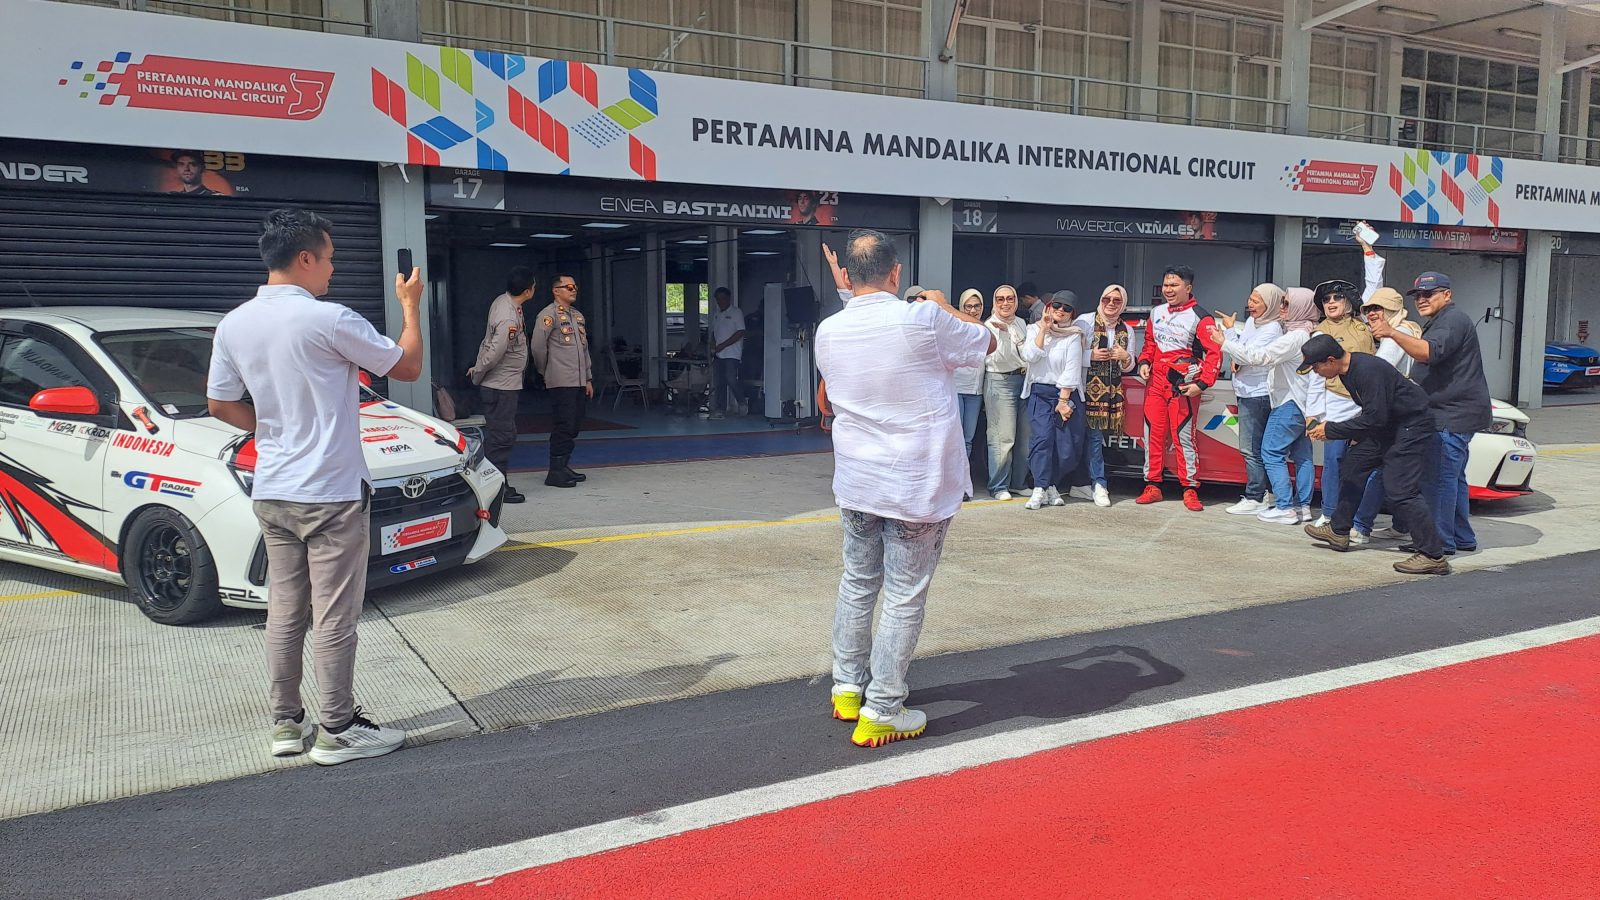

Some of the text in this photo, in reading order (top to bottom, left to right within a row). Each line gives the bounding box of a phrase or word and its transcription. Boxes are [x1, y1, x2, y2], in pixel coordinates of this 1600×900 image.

[136, 71, 288, 93] PERTAMINA MANDALIKA
[137, 83, 285, 105] INTERNATIONAL CIRCUIT
[692, 117, 1256, 180] PERTAMINA MANDALIKA INTERNATIONAL CIRCUIT
[454, 168, 481, 177] GARAGE
[1306, 169, 1333, 177] PERTAMINA
[452, 177, 483, 199] 17
[1306, 177, 1342, 185] INTERNATIONAL
[819, 191, 839, 206] 23
[1515, 183, 1586, 205] PERTAMINA
[600, 197, 792, 219] ENEA BASTIANINI
[962, 209, 983, 226] 18
[1056, 218, 1195, 236] MAVERICK VIÑALES
[1304, 224, 1319, 239] 19
[1393, 229, 1471, 242] BMW TEAM ASTRA
[1551, 236, 1562, 250] 20
[48, 420, 77, 434] MGPA
[112, 433, 175, 457] INDONESIA
[380, 444, 413, 455] MGPA
[1101, 435, 1146, 449] AFETY
[161, 483, 197, 494] RADIAL
